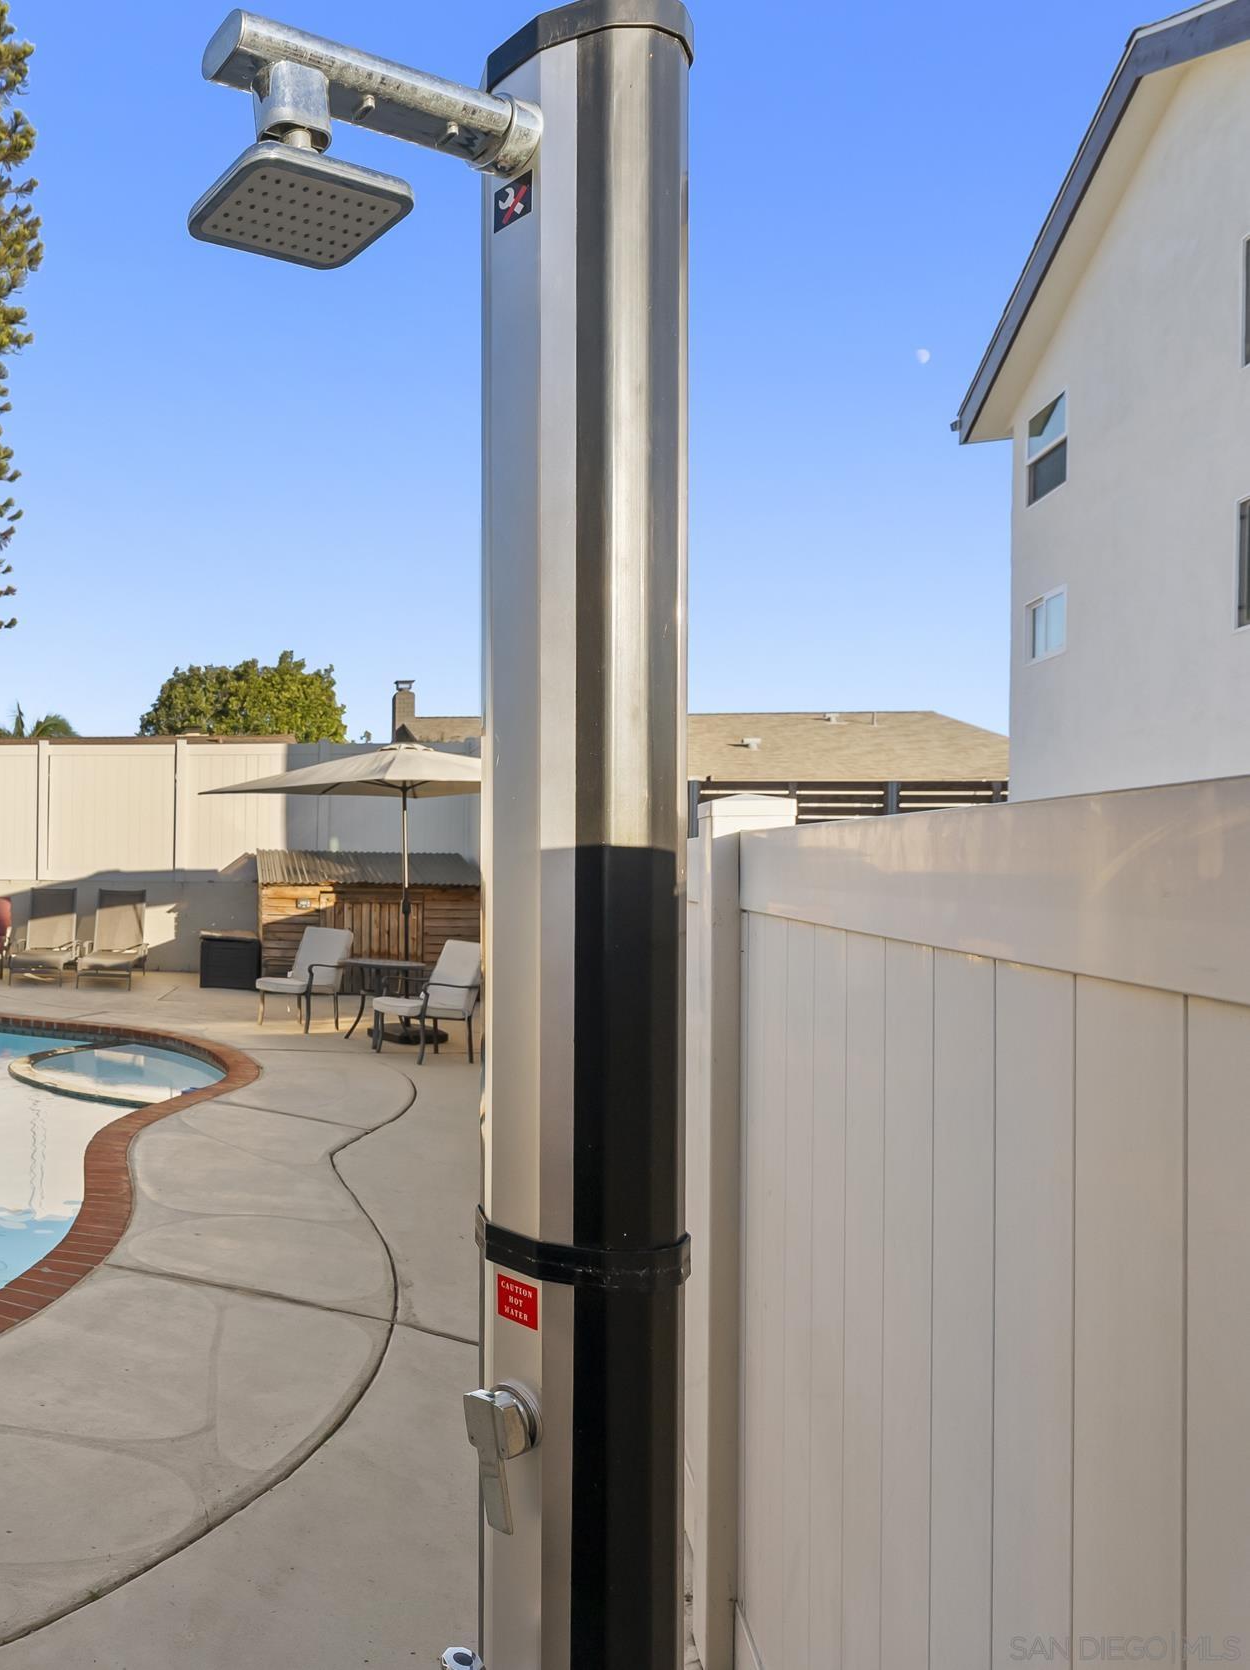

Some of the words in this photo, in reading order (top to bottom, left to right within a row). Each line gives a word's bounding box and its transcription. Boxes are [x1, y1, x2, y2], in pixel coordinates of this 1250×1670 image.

[501, 1280, 532, 1298] CAUTION
[508, 1295, 523, 1307] HOT
[504, 1305, 528, 1321] WATER
